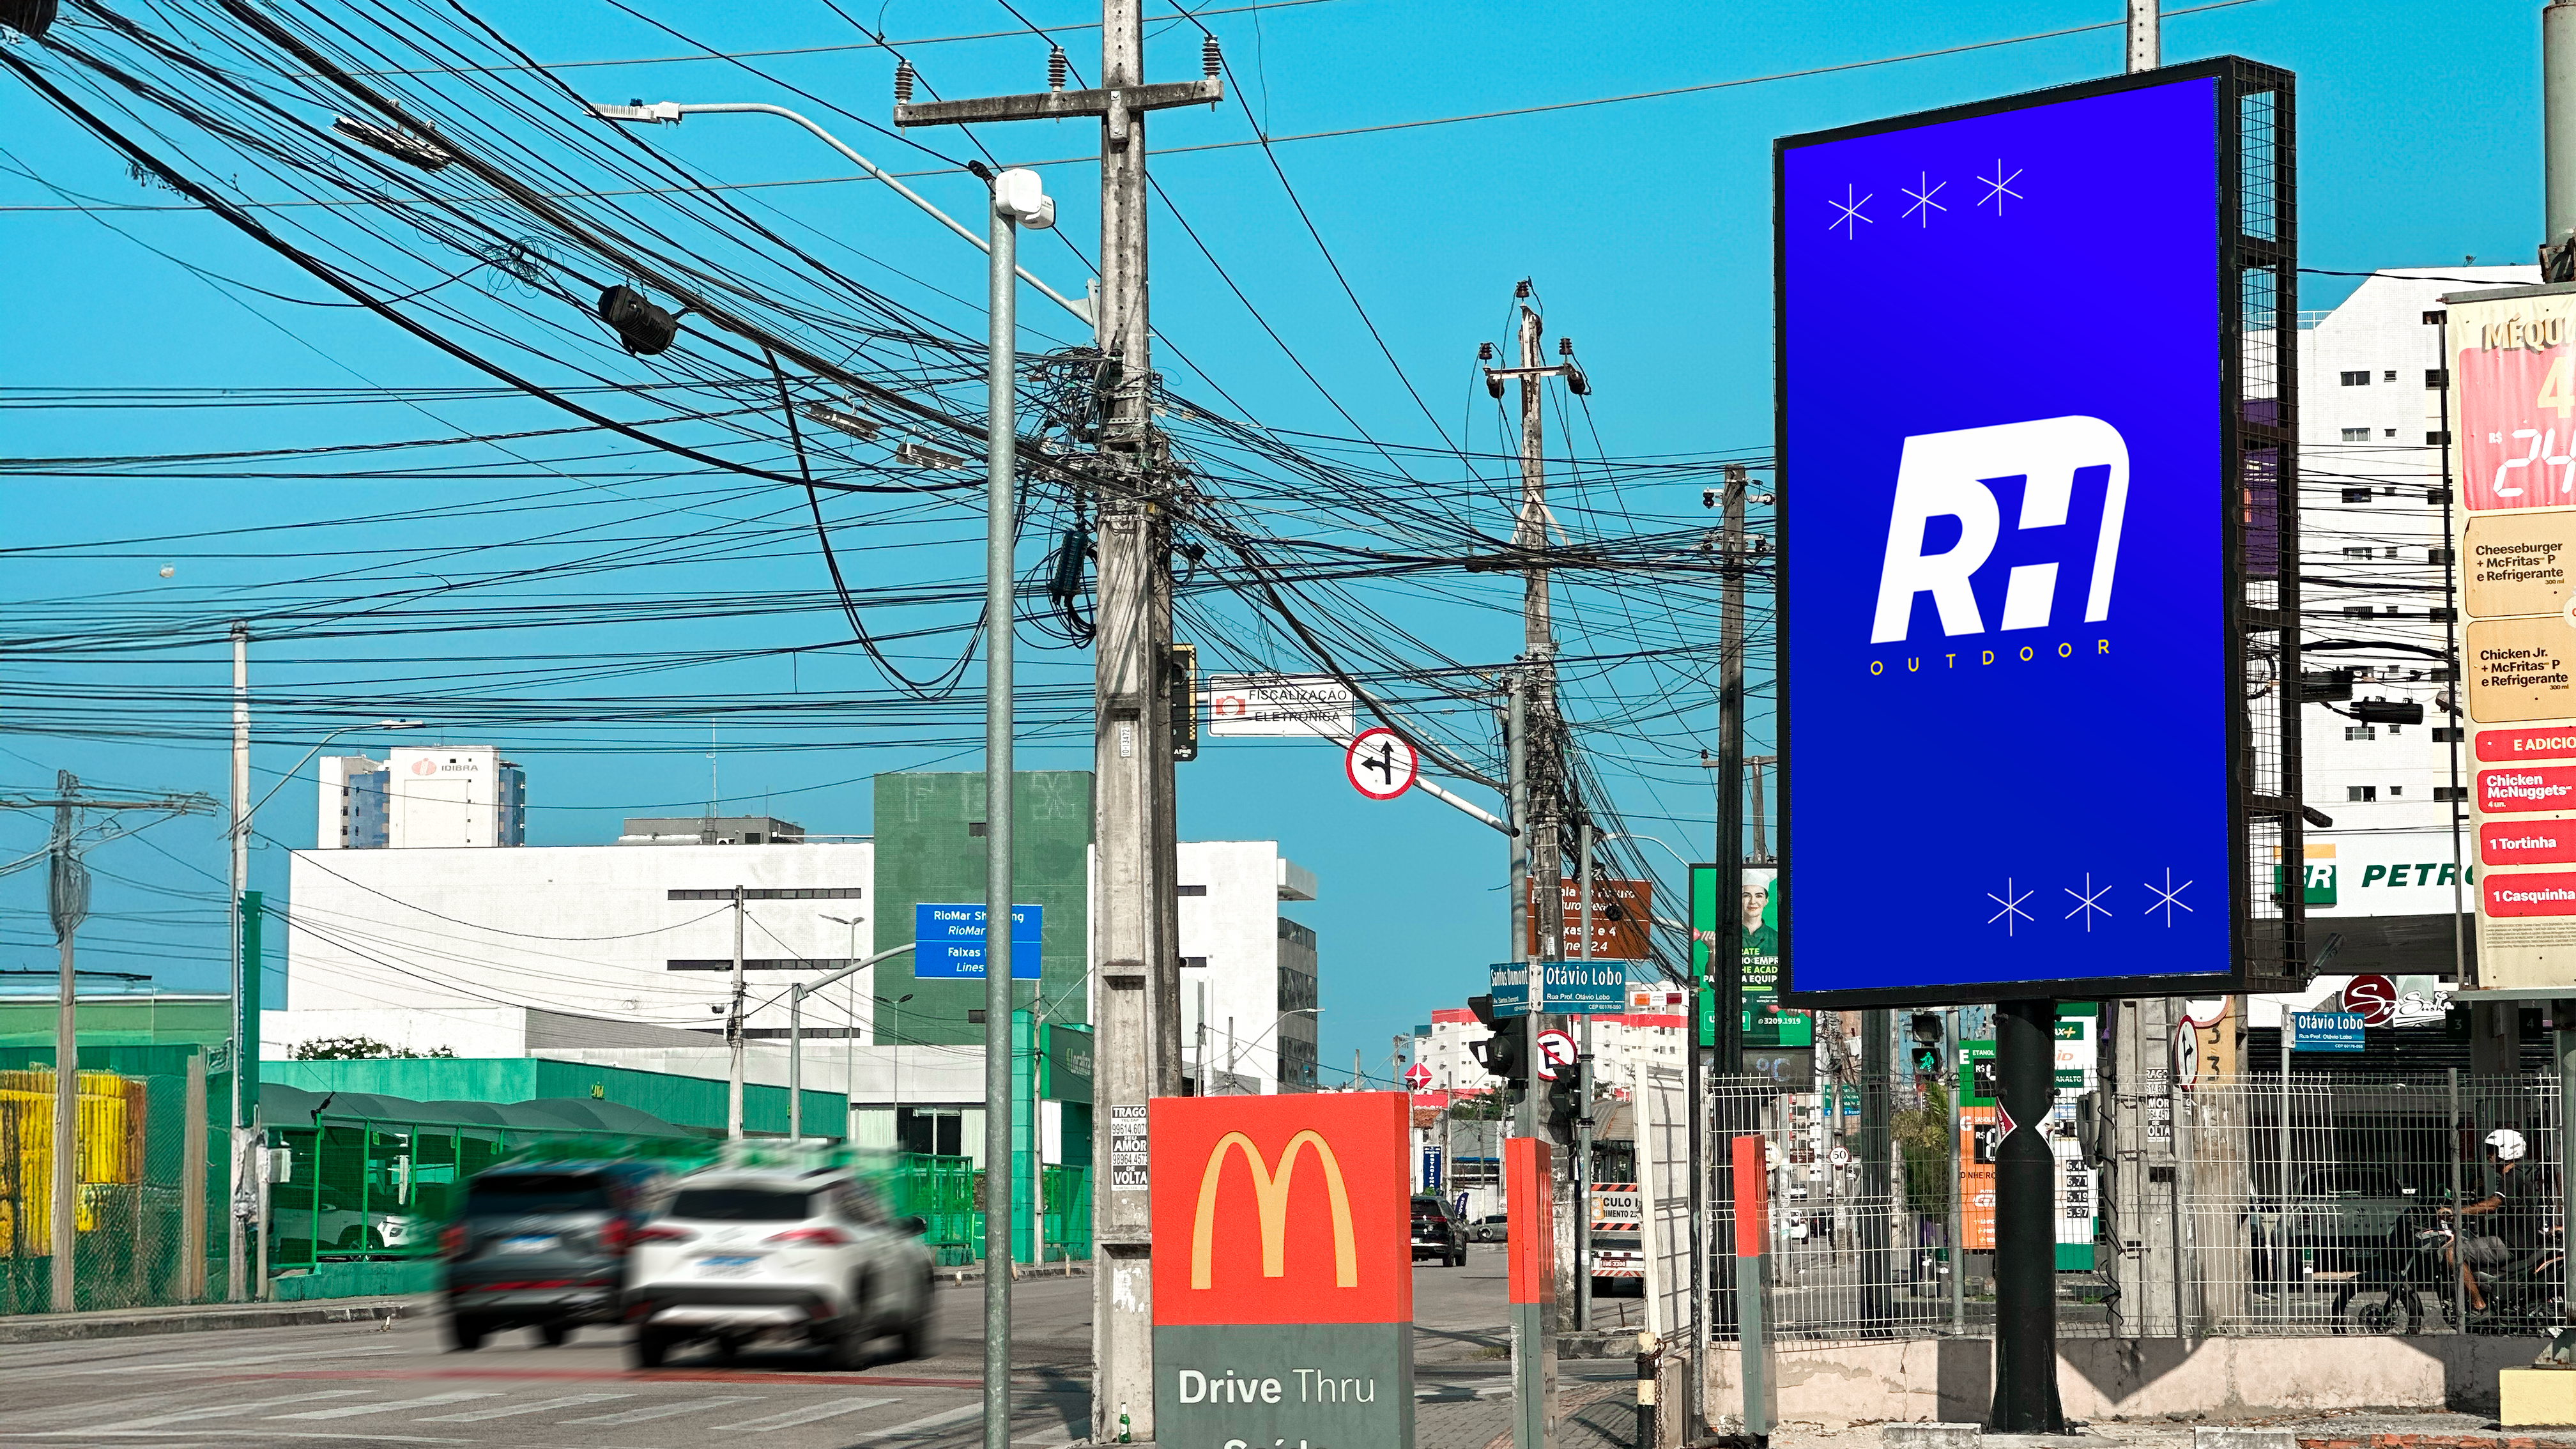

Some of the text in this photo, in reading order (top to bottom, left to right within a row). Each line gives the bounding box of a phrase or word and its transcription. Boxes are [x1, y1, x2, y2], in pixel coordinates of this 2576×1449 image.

[2488, 431, 2503, 445] R$
[2476, 542, 2563, 556] Cheeseburger
[2548, 555, 2556, 564] P
[2477, 567, 2563, 582] e Refrigerante
[1871, 640, 2110, 675] OUTDOOR
[2480, 647, 2548, 661] Chicken Jr.
[2552, 659, 2560, 670] P
[2481, 673, 2568, 687] e Refrigerante
[1248, 687, 1347, 702] FISCALIZAÇÃO
[1255, 709, 1341, 723] ELETRÔNICA
[2513, 739, 2522, 751] E
[2487, 774, 2543, 787] Chicken
[2490, 836, 2557, 850] 1 Tortinha
[2493, 888, 2576, 904] 1 Casquinha
[934, 910, 1025, 924] RioMar Shng
[948, 926, 986, 936] RioMar
[1609, 926, 1616, 937] 4
[948, 947, 981, 957] Faixas
[1591, 941, 1608, 952] 2,4
[956, 962, 985, 972] Lines
[1491, 966, 1528, 986] Santos Dumont
[1546, 966, 1622, 986] Otávio Lobo
[2299, 1014, 2363, 1030] Otávio Lobo
[1959, 1049, 1970, 1064] E
[1975, 1064, 1986, 1073] R$
[2147, 1098, 2170, 1108] MOR
[1113, 1107, 1146, 1117] TRAGO
[1959, 1116, 1972, 1131] G
[2147, 1125, 2170, 1137] OLTA
[1114, 1140, 1147, 1152] AMOR
[1832, 1151, 1846, 1160] 50
[1114, 1172, 1147, 1184] VOLTA
[1179, 1368, 1374, 1404] Drive Thru
